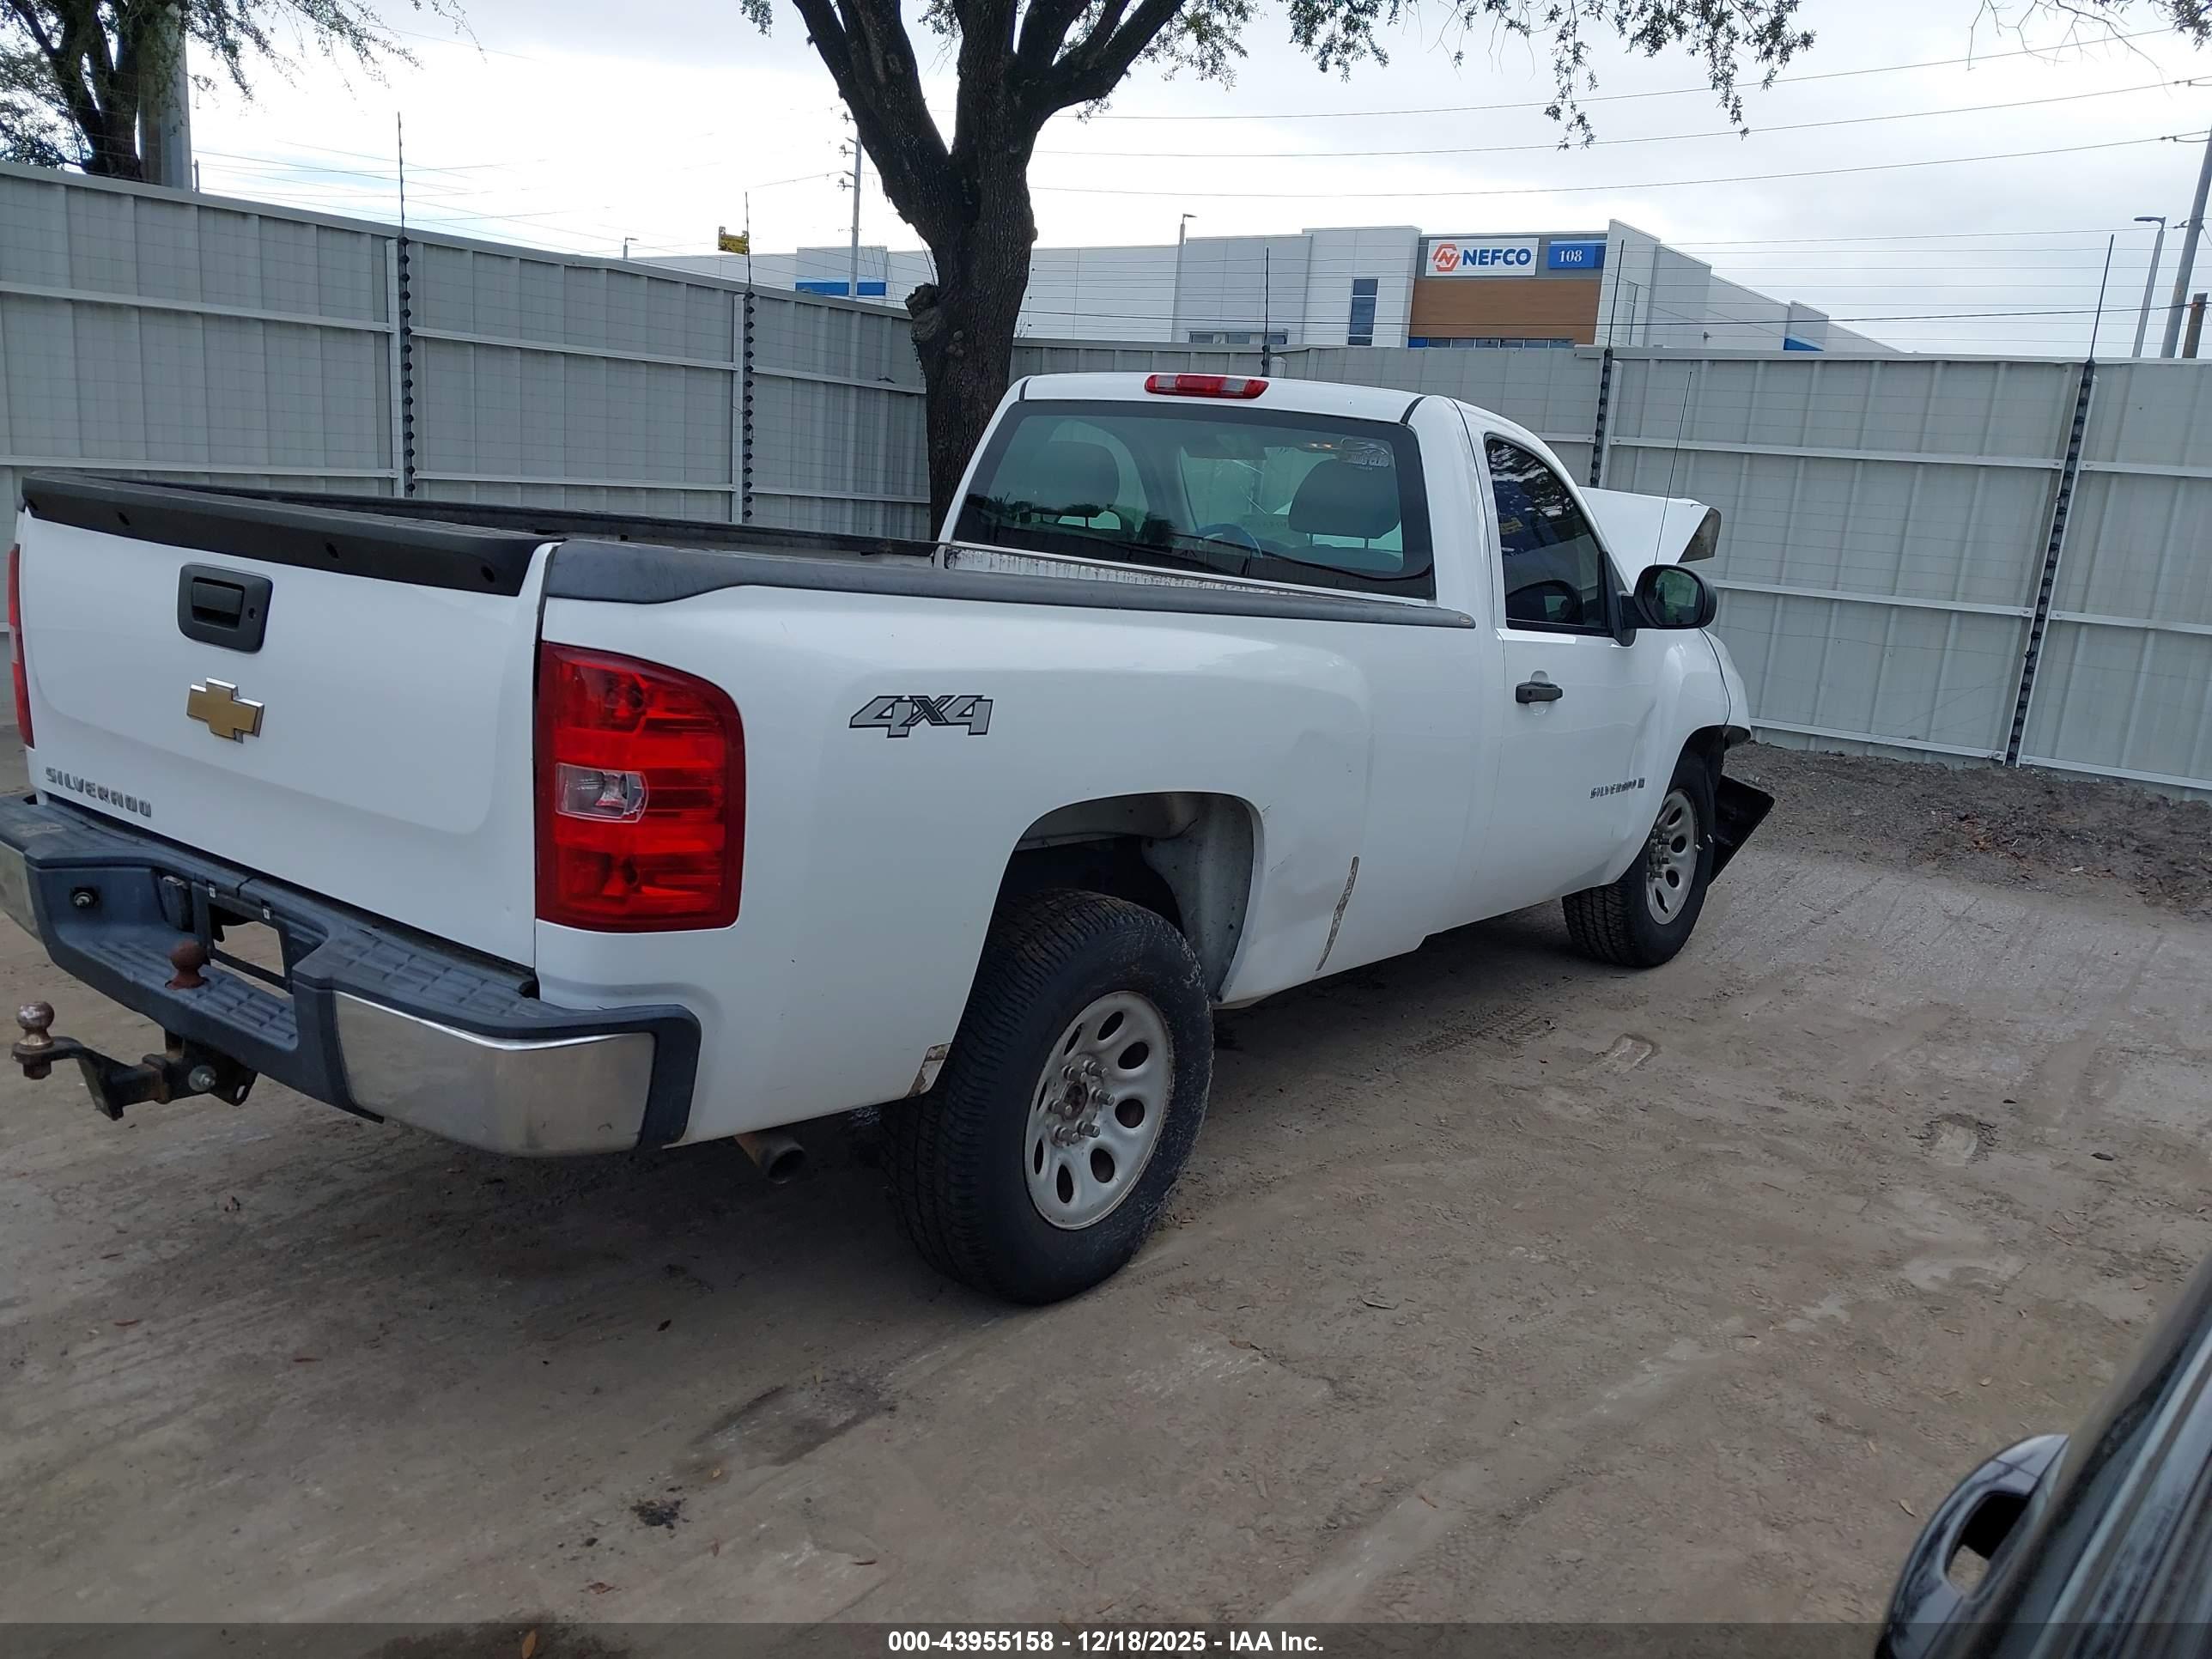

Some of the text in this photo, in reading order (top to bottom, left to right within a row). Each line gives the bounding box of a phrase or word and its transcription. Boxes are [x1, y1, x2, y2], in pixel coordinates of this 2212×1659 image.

[1462, 247, 1532, 266] NEFCO
[1559, 249, 1583, 263] 108
[45, 766, 153, 818] SILVERADO
